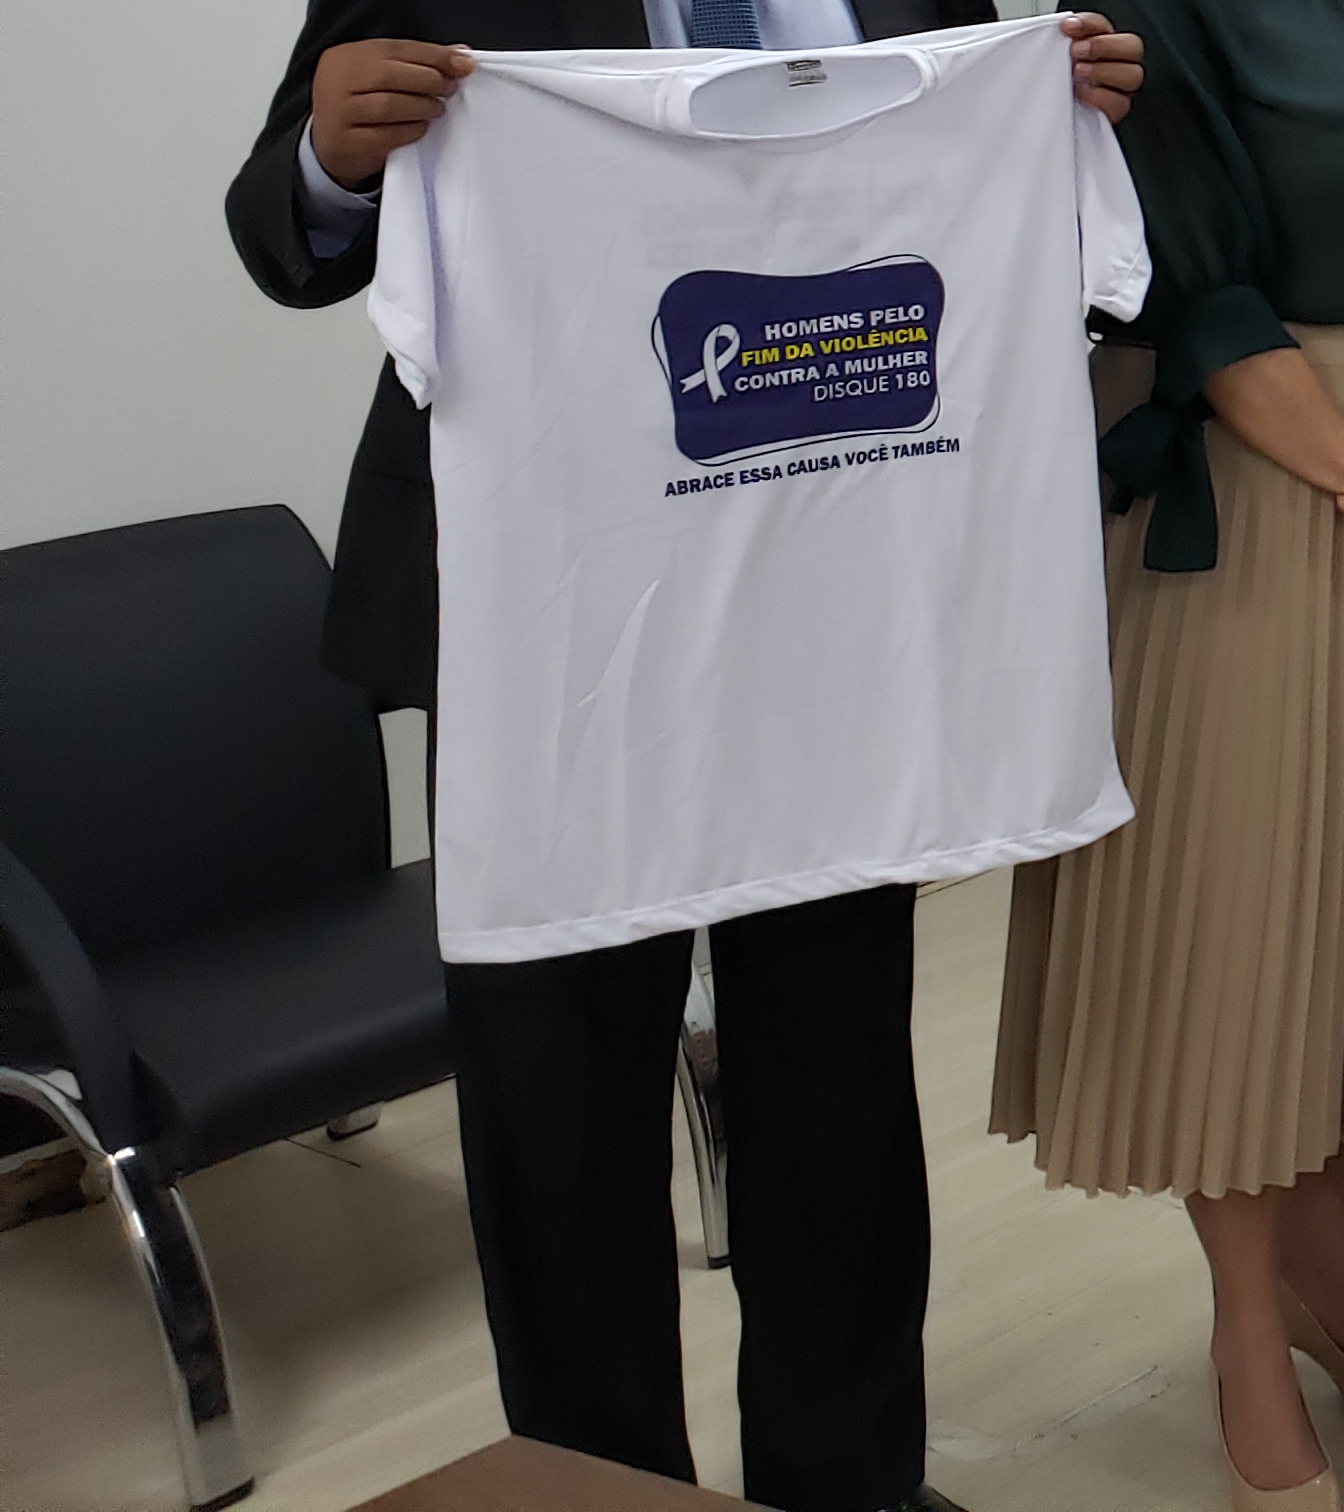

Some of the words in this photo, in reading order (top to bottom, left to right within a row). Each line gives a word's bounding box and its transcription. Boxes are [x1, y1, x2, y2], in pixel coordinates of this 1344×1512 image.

[764, 312, 865, 341] HOMENS
[870, 304, 925, 327] PELO
[741, 346, 779, 367] FIM
[785, 342, 815, 361] DA
[820, 326, 928, 355] VIOLÊNCIA
[734, 366, 820, 392] CONTRA
[825, 362, 840, 379] A
[845, 350, 928, 375] MULHER
[813, 376, 889, 402] DISQUE
[895, 369, 931, 390] 180
[664, 472, 735, 498] ABRACE
[739, 464, 783, 485] ESSA
[787, 454, 841, 476] CAUSA
[845, 443, 889, 466] VOCÊ
[892, 436, 960, 459] TAMBÉM
